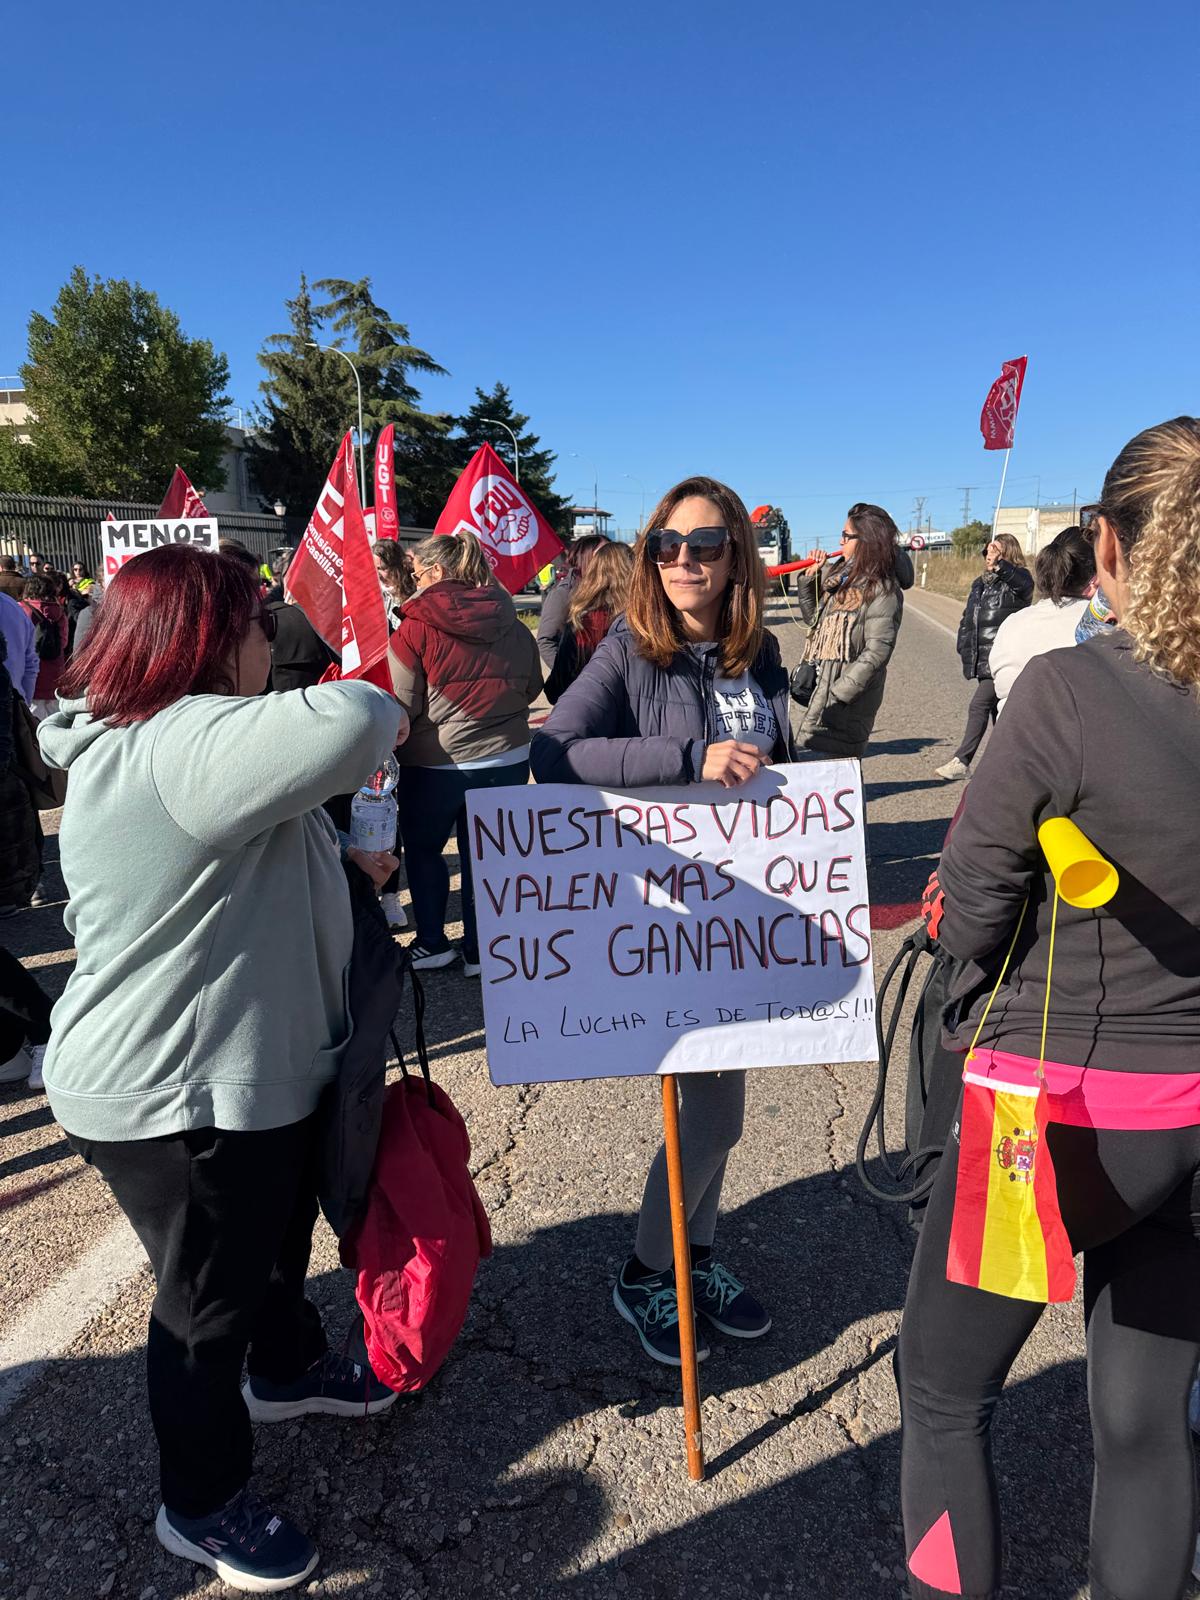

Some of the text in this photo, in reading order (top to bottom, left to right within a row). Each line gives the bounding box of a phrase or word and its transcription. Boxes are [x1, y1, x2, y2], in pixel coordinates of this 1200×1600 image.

[378, 444, 390, 504] UGT
[107, 523, 212, 548] MENOS
[474, 789, 855, 860] NUESTRAS VIDAS
[483, 852, 853, 917] VALEN MÁS QUE
[489, 904, 871, 984] SUS GANANCIAS
[503, 998, 874, 1044] LA LUCHA ES DE TOD@S!!!
